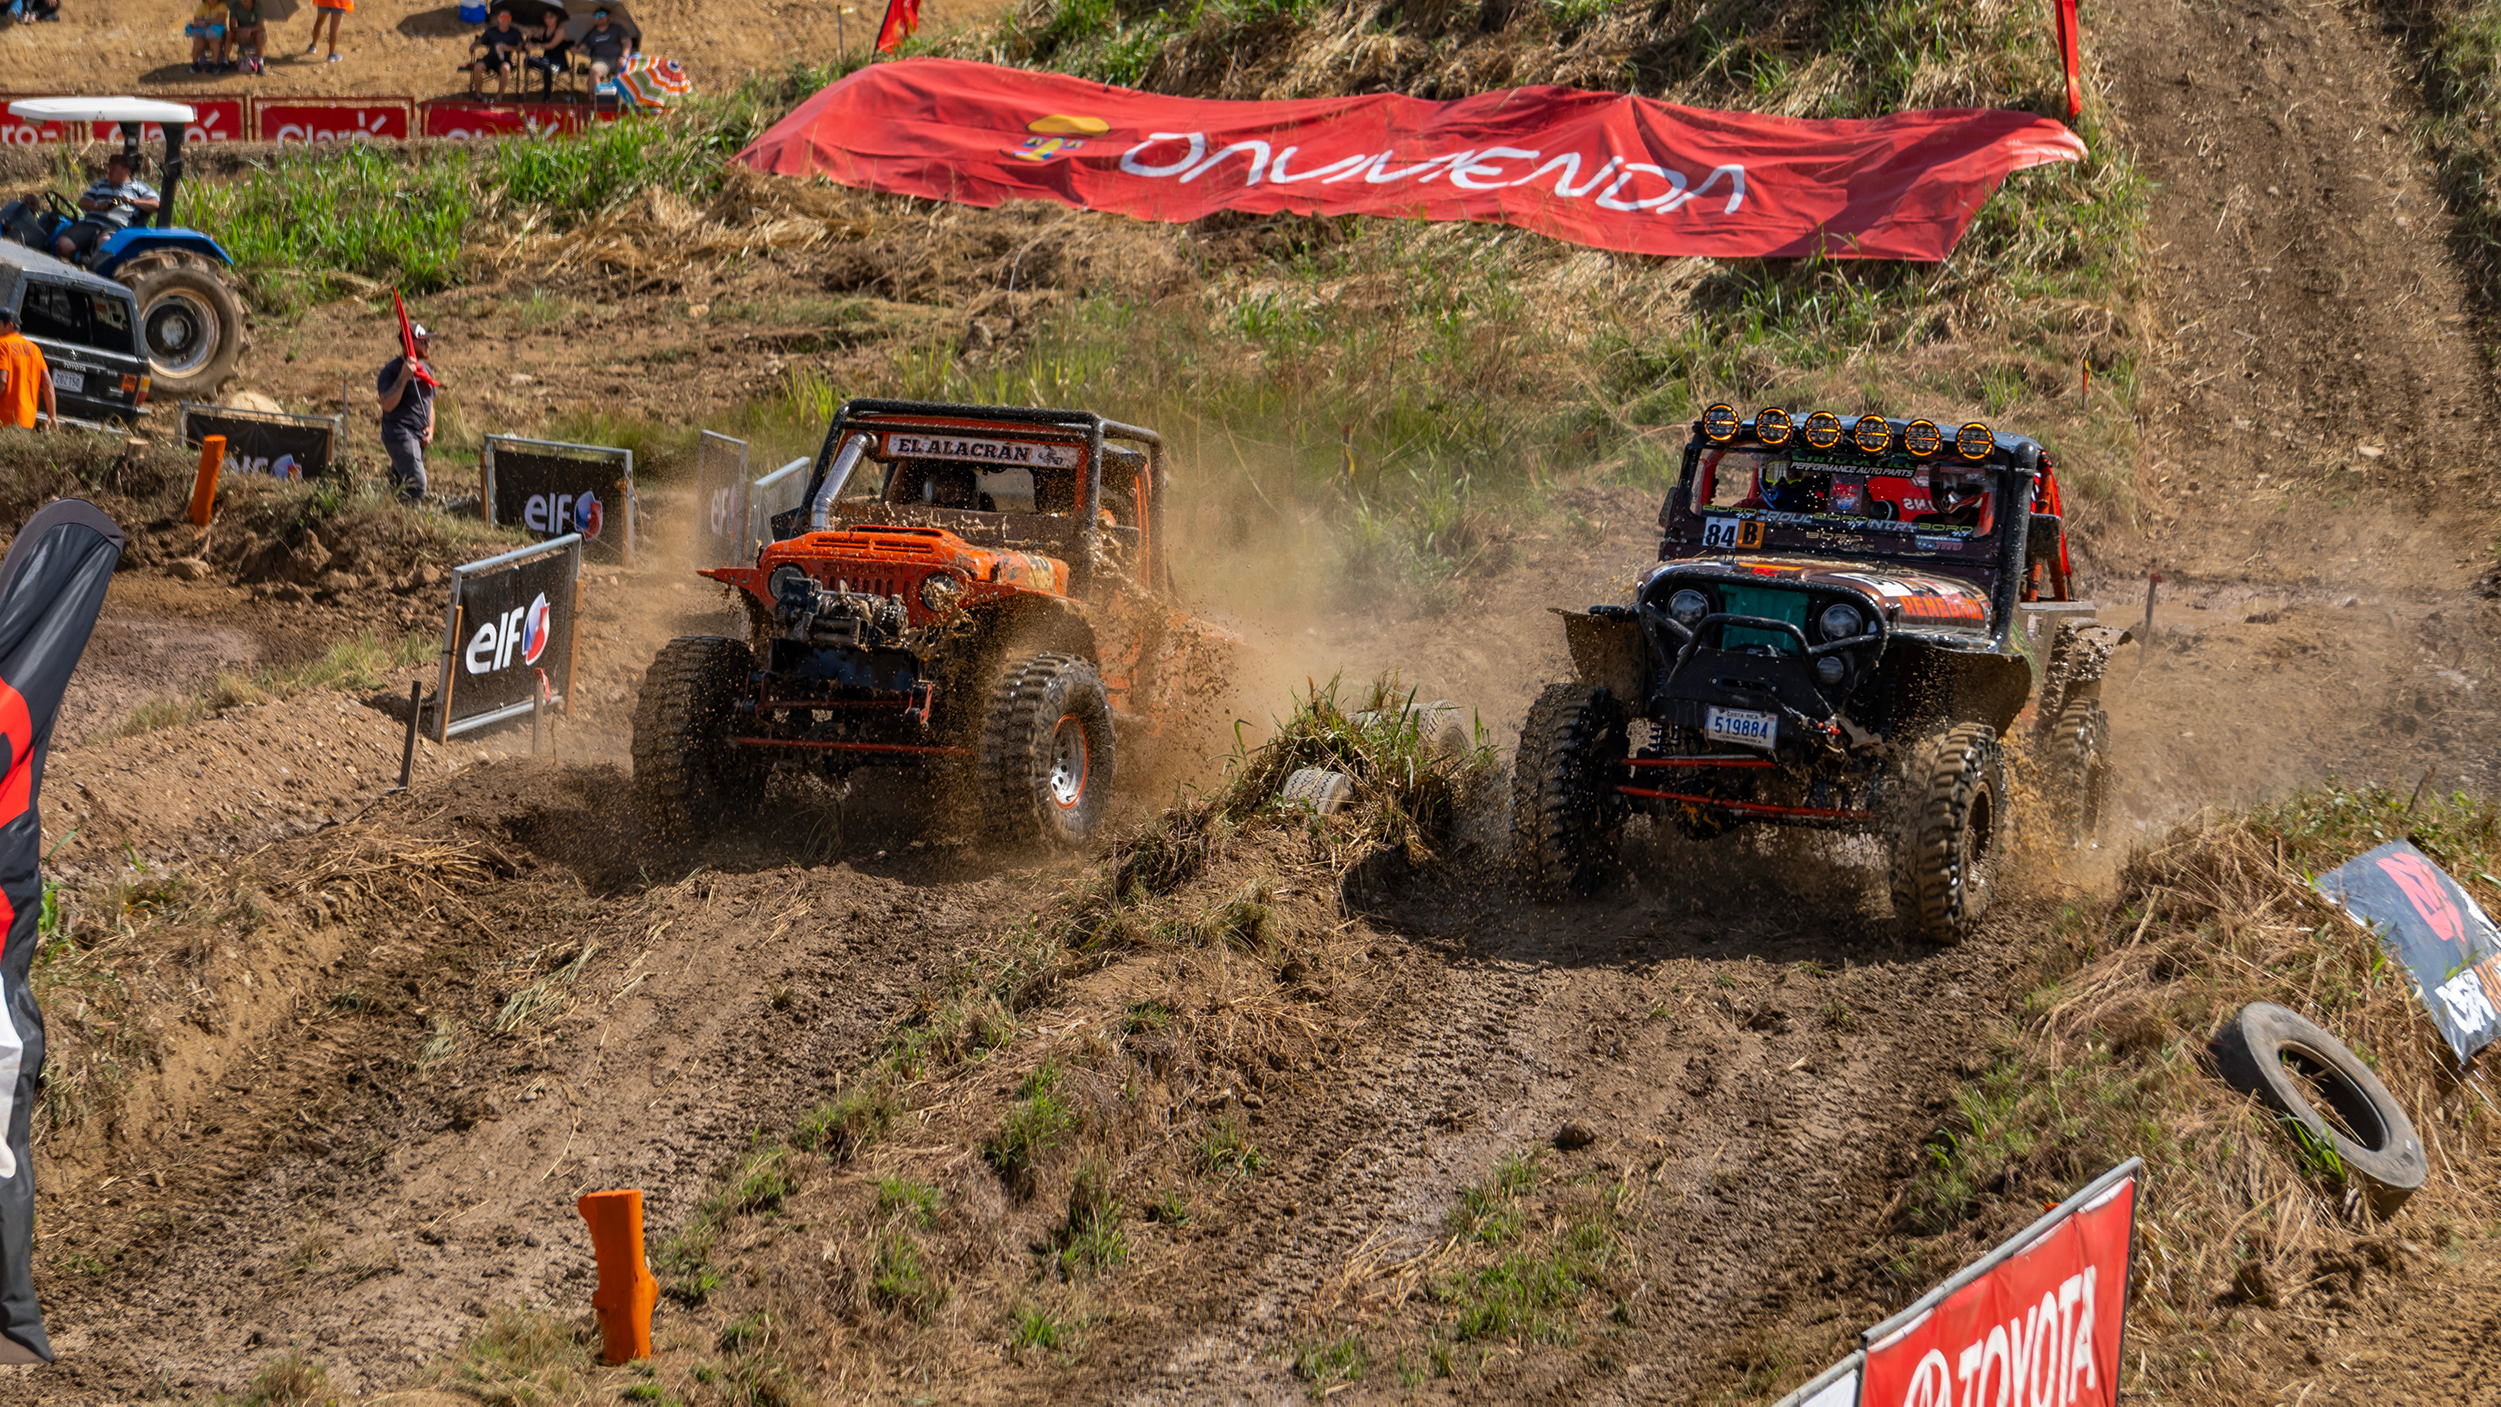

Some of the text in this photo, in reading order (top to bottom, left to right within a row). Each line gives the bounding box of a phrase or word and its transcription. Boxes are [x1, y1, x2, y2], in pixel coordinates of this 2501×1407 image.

[109, 121, 208, 145] Clao
[1119, 132, 1745, 214] DAVIVIENDA
[898, 438, 1031, 461] EL ALACRÁN
[1790, 461, 1856, 474] PERFORMANCE
[1856, 465, 1882, 475] AUTO
[1882, 468, 1915, 478] PARTS
[524, 493, 572, 535] elf
[1703, 505, 1757, 516] BORO
[1814, 512, 1868, 522] BORO
[1705, 522, 1759, 547] 84 B
[1919, 522, 1973, 532] BORO
[823, 562, 903, 575] SUZUKI
[466, 606, 525, 675] elf
[1727, 711, 1744, 719] COSTA
[1714, 716, 1768, 740] 519884
[1958, 1264, 2097, 1407] TOYOTA
